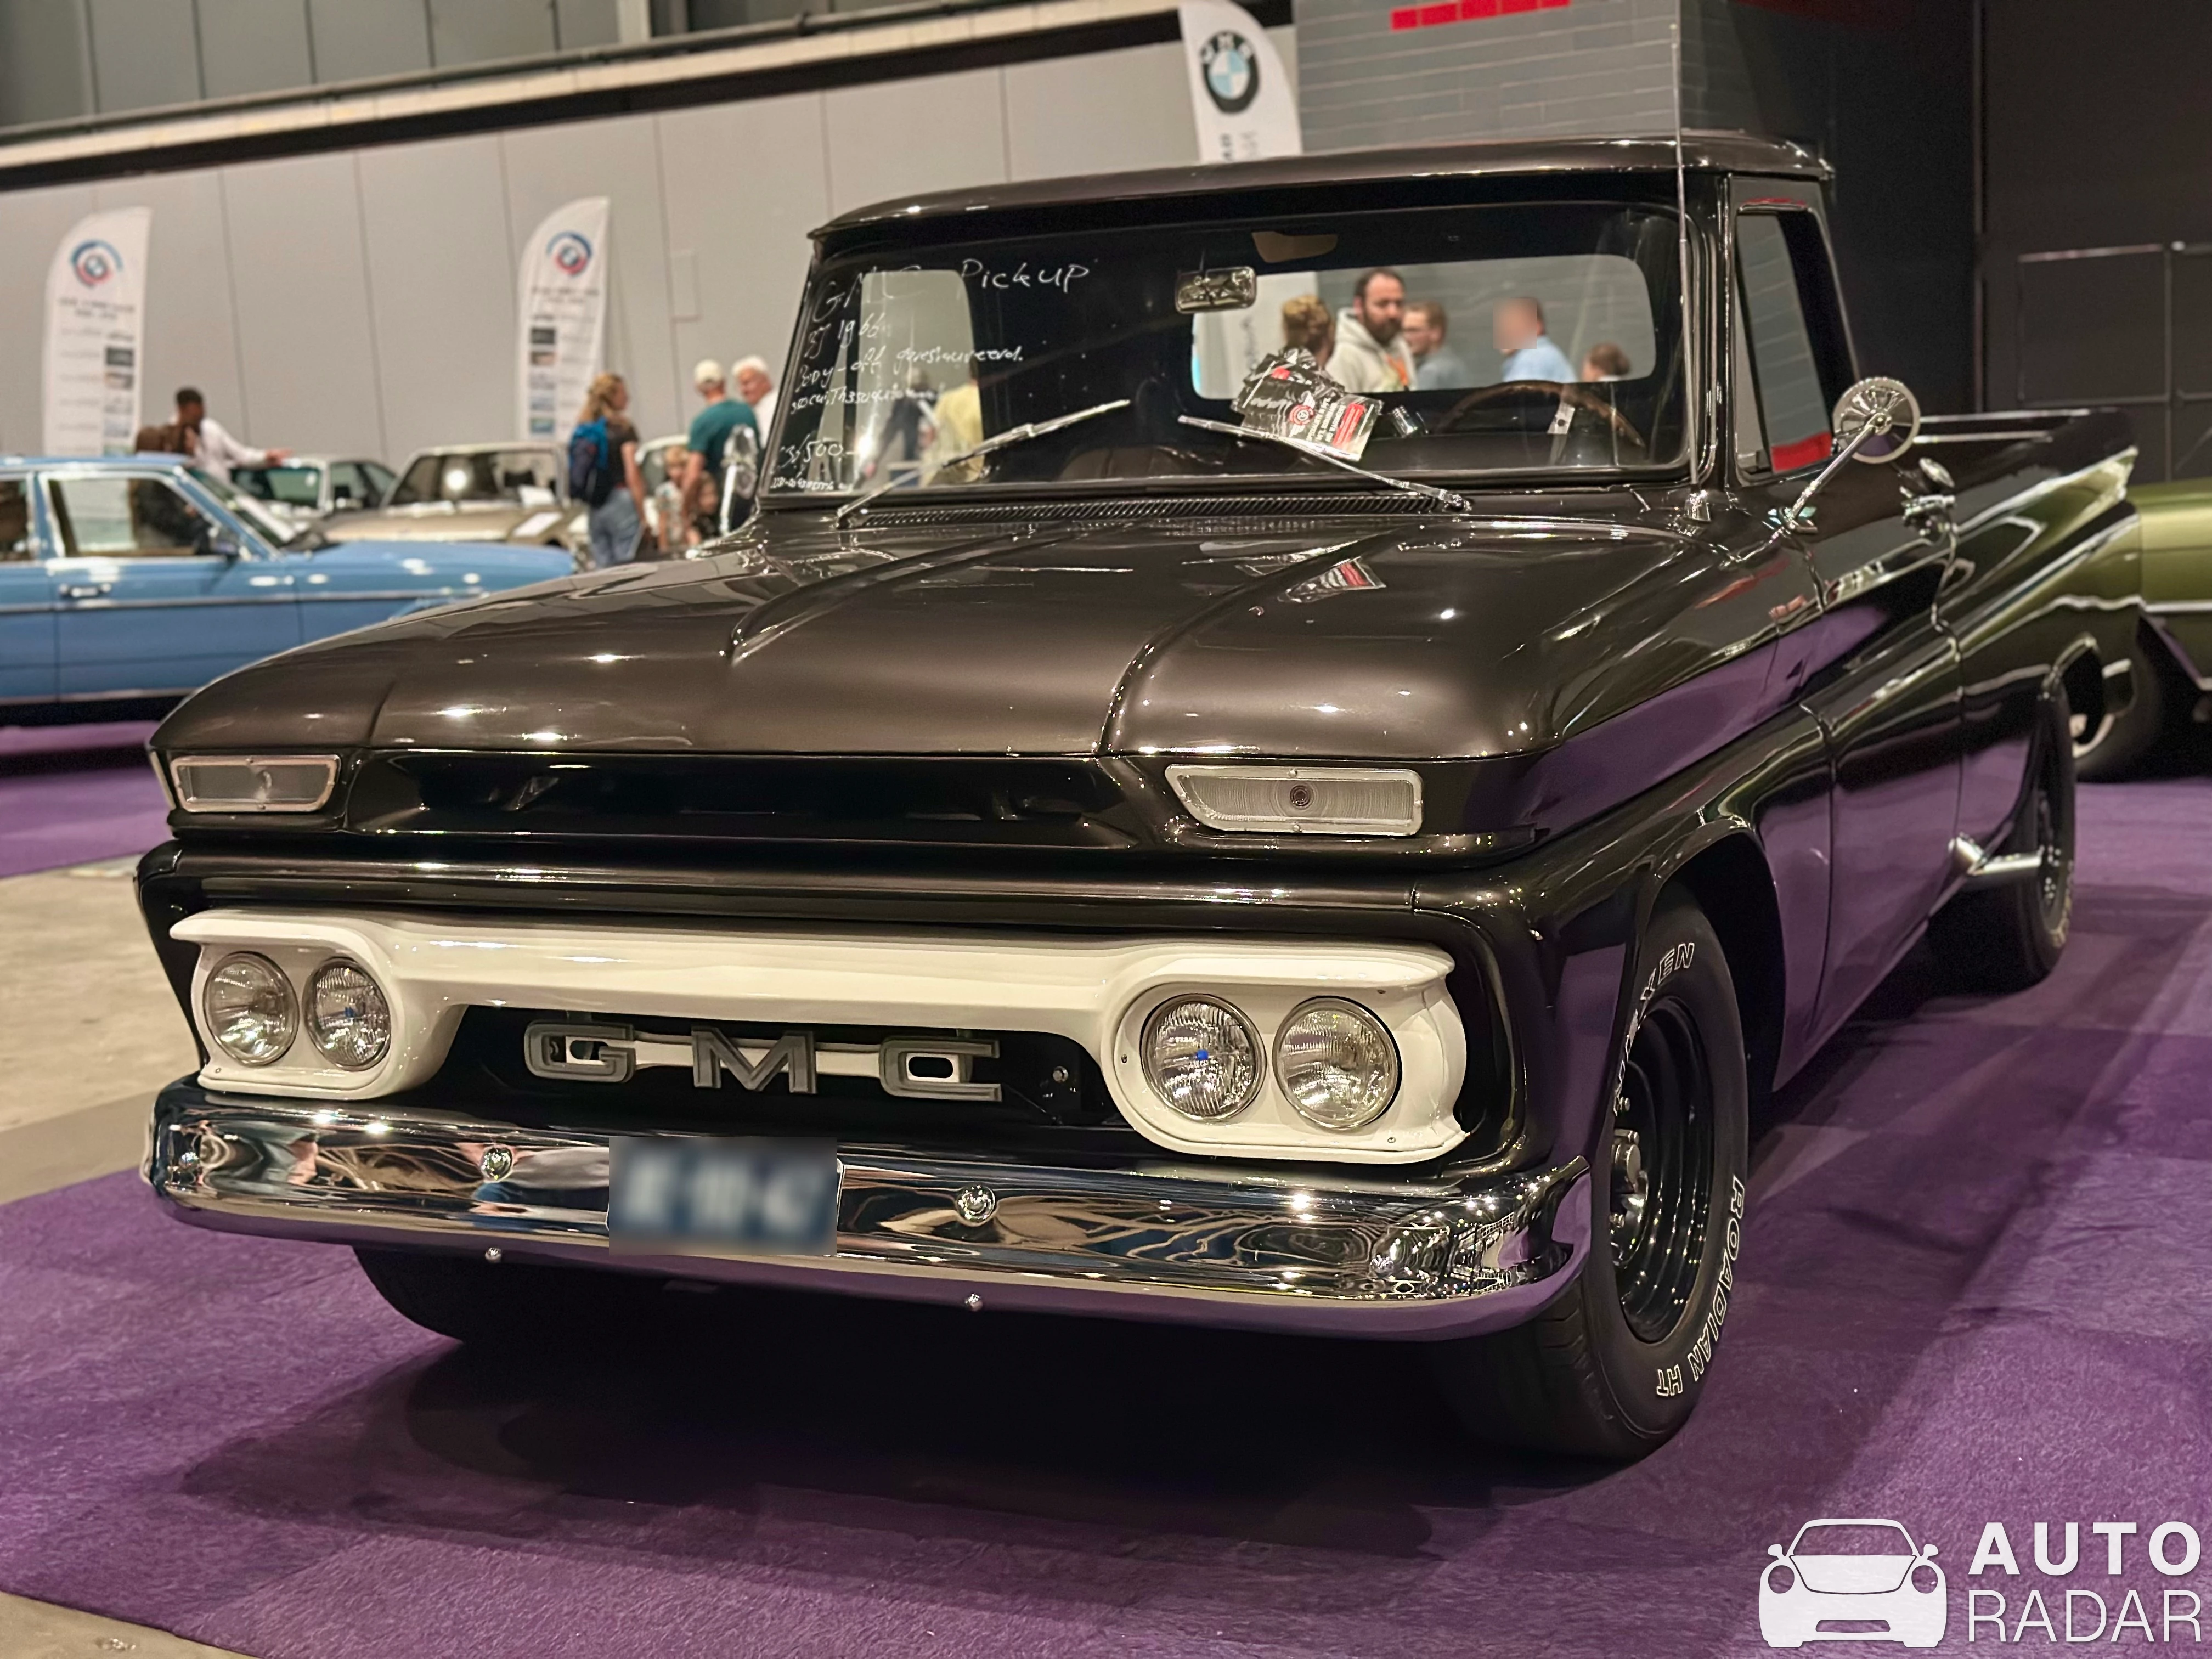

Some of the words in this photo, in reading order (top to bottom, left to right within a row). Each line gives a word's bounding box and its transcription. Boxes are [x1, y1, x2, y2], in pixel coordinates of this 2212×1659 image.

[524, 1019, 1002, 1102] GMC
[1687, 1174, 1745, 1382] ROADIAN
[1656, 1364, 1684, 1397] HT
